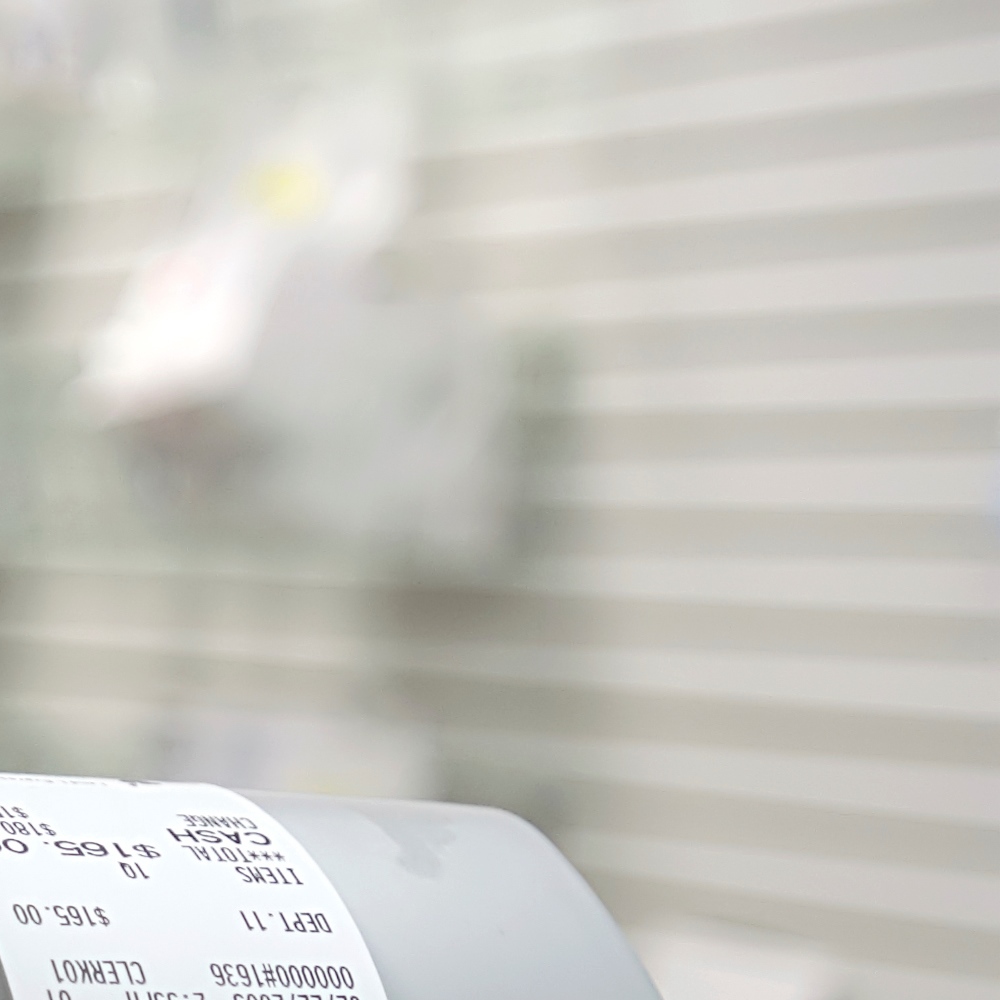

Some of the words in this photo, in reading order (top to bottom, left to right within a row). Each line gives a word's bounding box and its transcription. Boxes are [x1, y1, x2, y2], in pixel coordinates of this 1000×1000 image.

[176, 814, 258, 830] CHANGE
[166, 828, 271, 846] CASH
[118, 861, 150, 879] 1Q
[235, 866, 304, 885] ITEMS
[12, 903, 110, 927] $165.00
[239, 910, 333, 933] DEPT.11
[50, 959, 146, 985] CLERK01
[209, 963, 354, 989] 000000#1636
